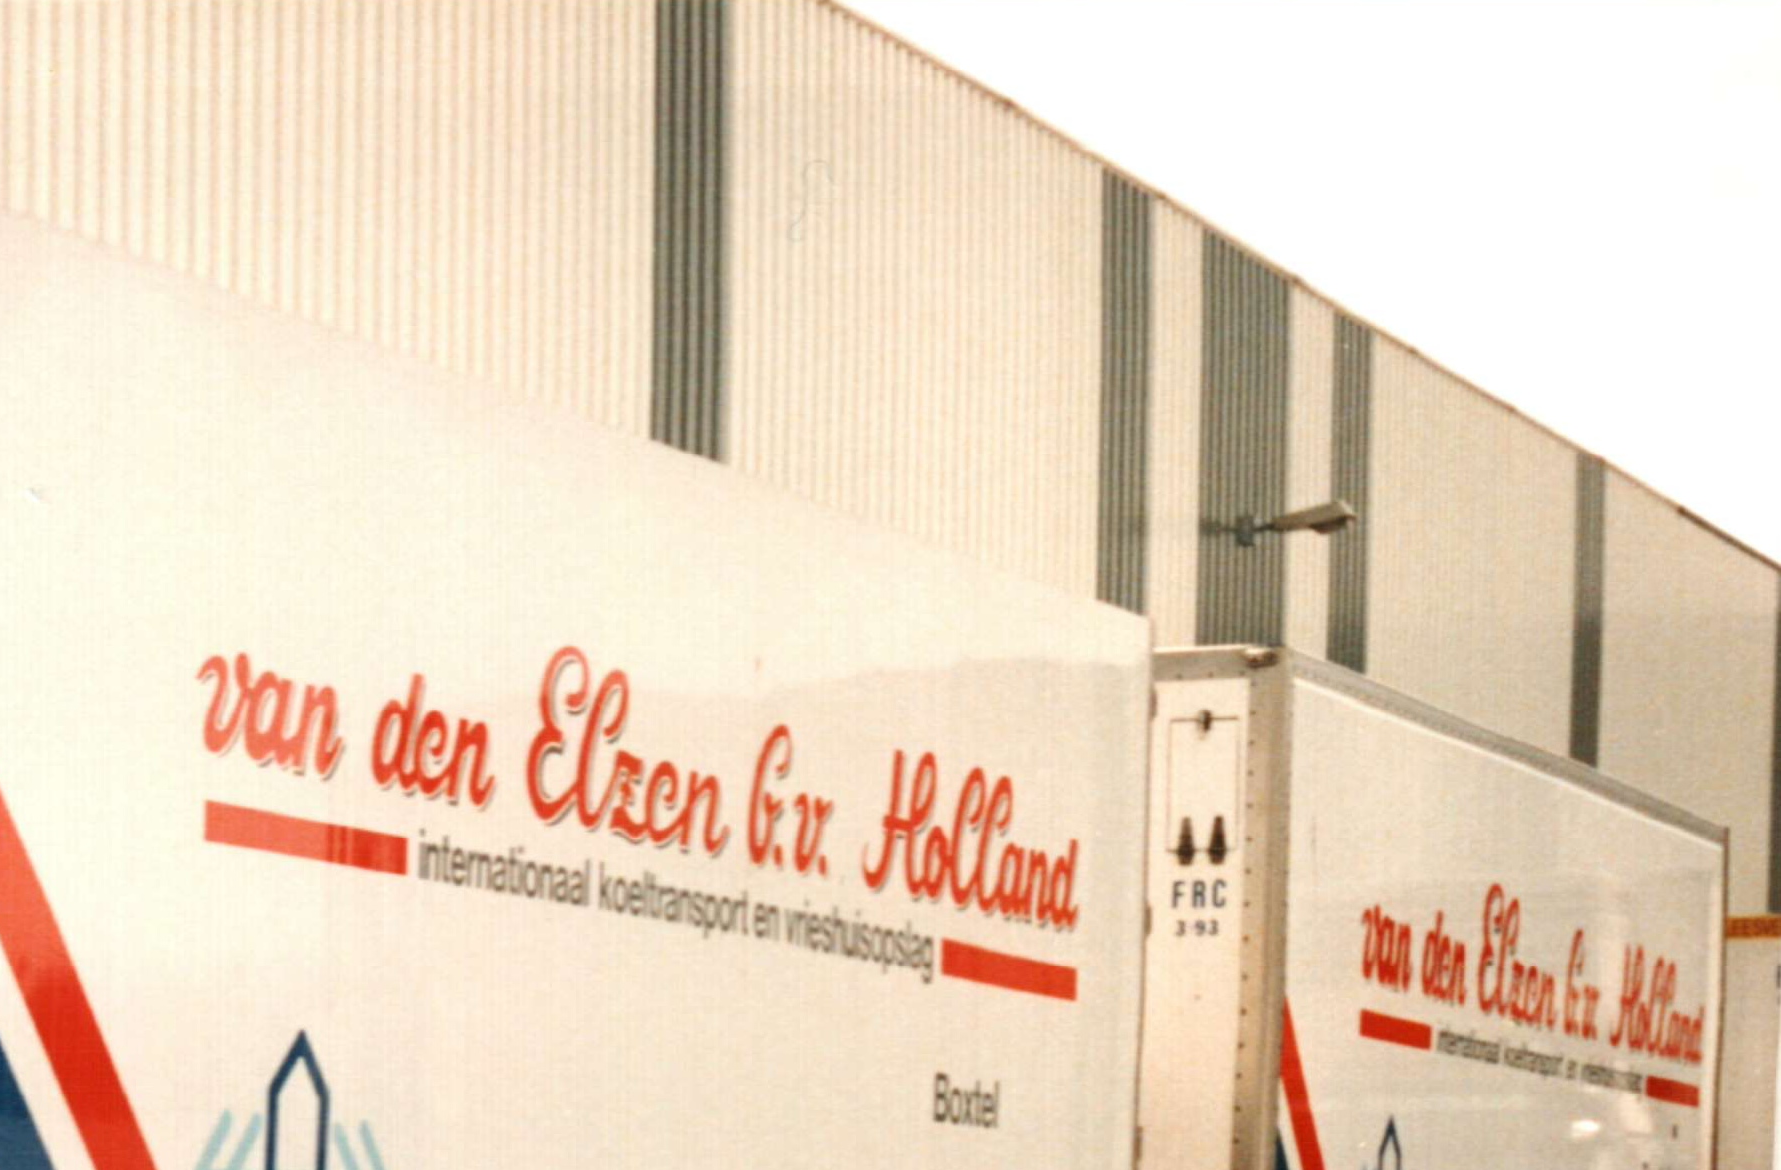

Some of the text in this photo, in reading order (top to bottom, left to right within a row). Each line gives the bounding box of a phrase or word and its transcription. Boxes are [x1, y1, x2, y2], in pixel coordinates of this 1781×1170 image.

[197, 652, 344, 782] van
[371, 673, 496, 810] den
[526, 645, 731, 858] Elzen
[863, 749, 1081, 930] Holland
[418, 828, 935, 983] internationaal koeltransport en vrieshuisopslag
[1171, 878, 1227, 909] FRC
[1361, 904, 1412, 992] van
[1421, 908, 1466, 1006] den
[933, 1071, 1000, 1128] Boxtel
